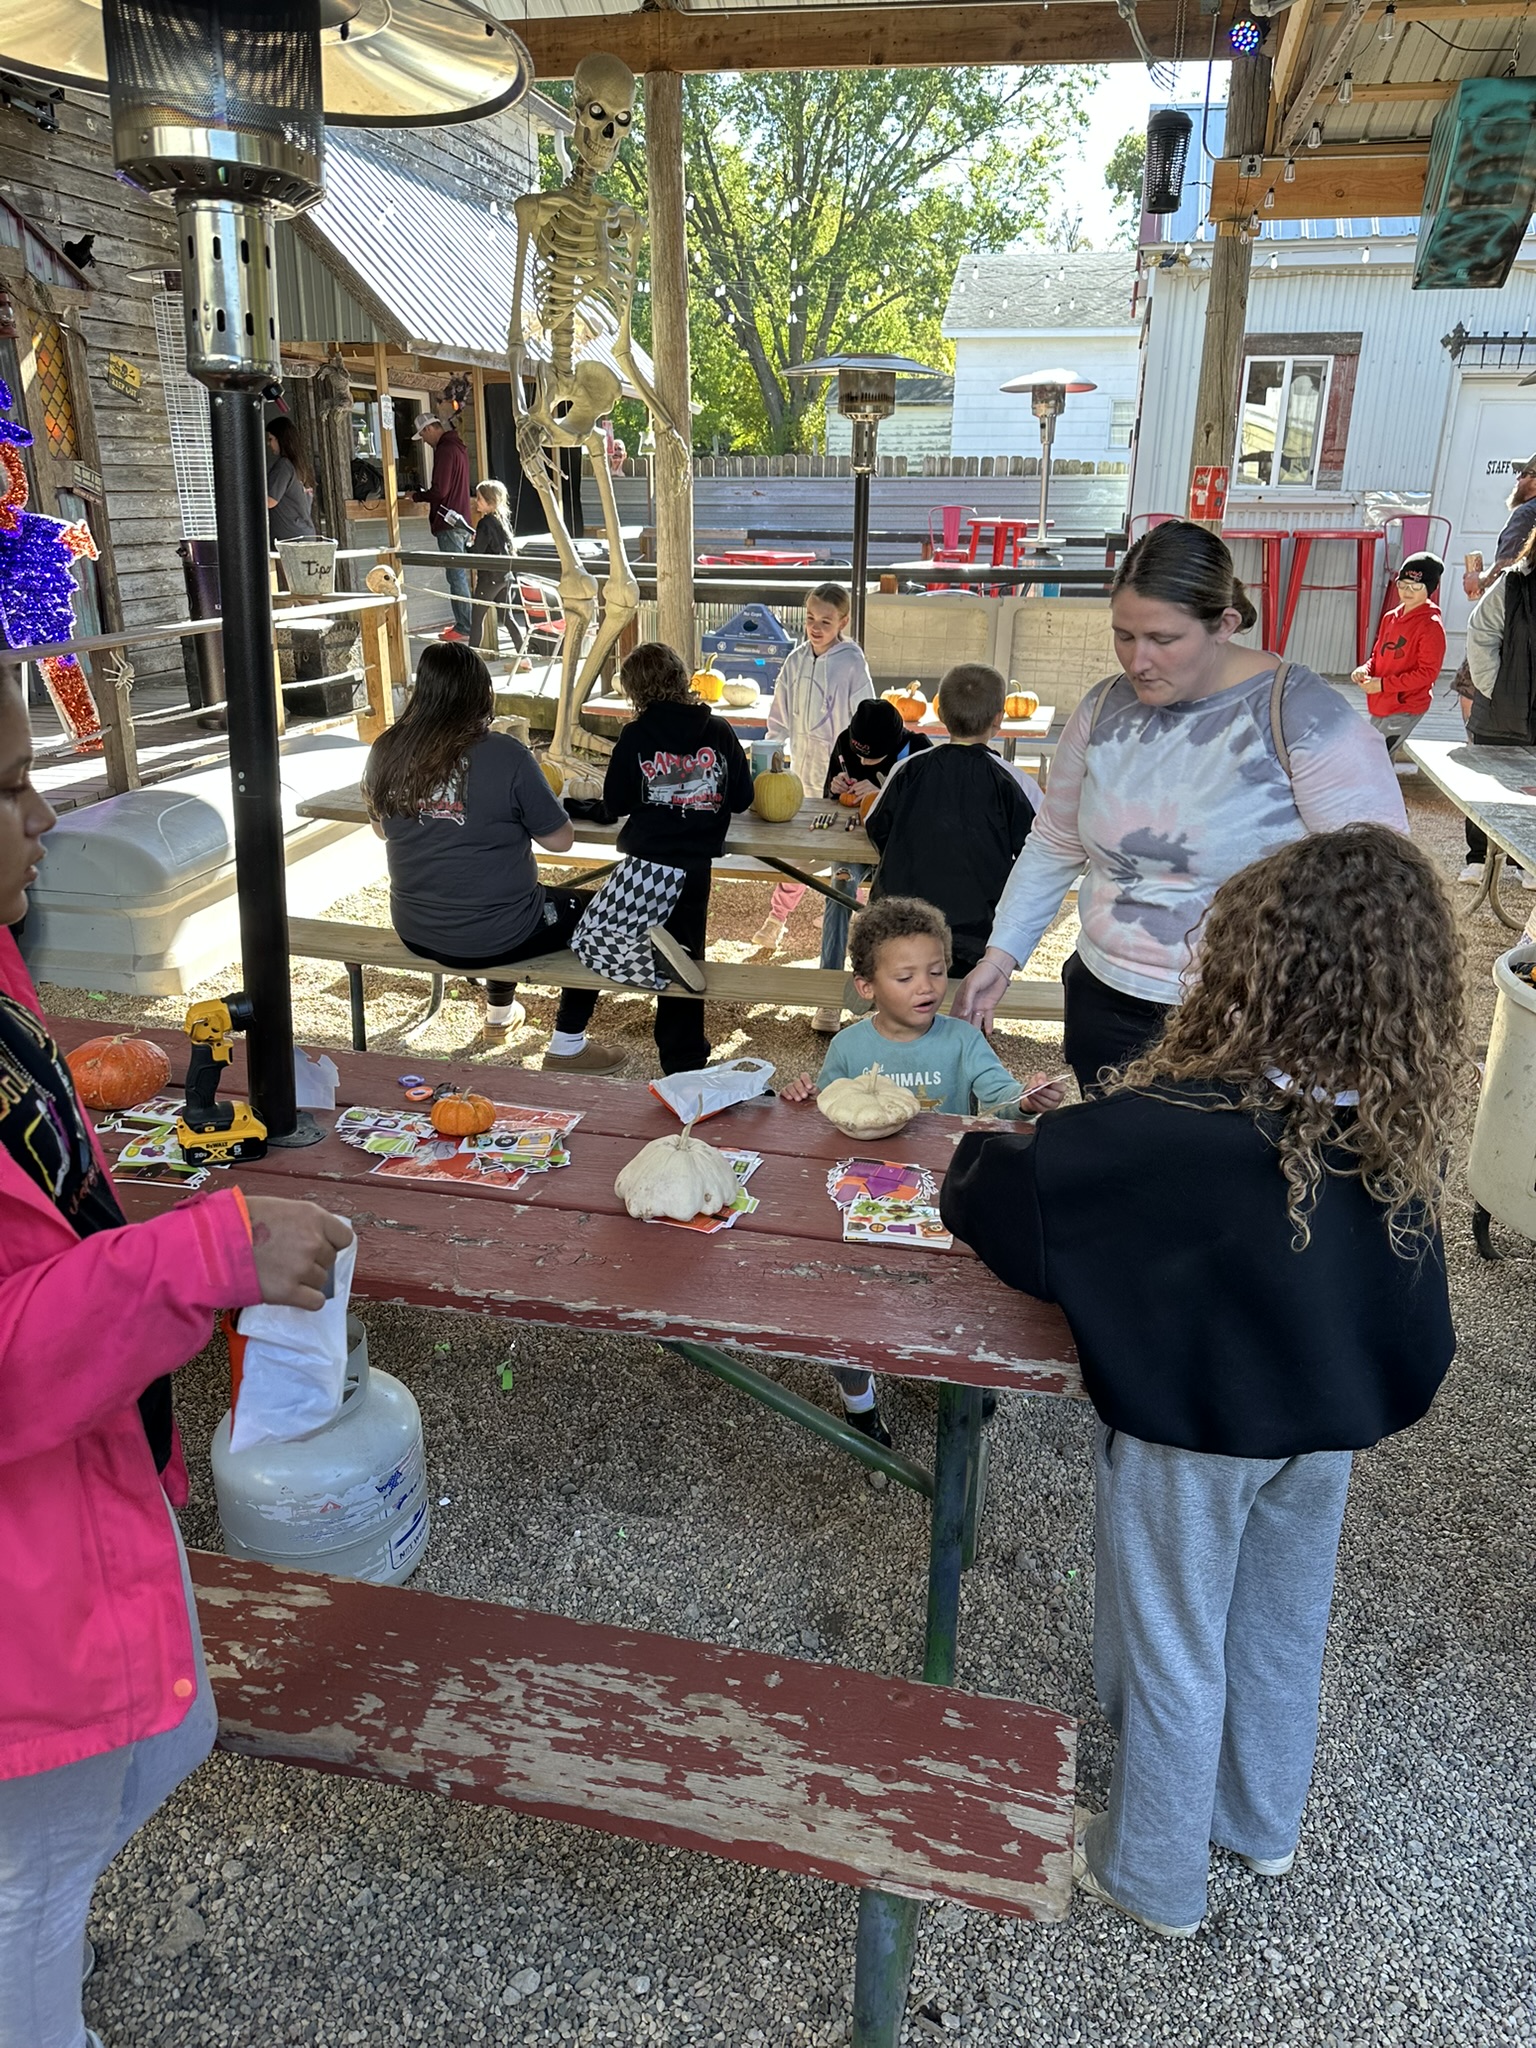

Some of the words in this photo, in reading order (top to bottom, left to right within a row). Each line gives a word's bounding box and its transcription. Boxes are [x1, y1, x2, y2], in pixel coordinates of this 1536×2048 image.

[1486, 460, 1512, 475] STAFF
[301, 560, 332, 580] Tips
[640, 747, 717, 782] BANGO
[877, 1070, 942, 1088] IMALS
[206, 1148, 231, 1161] XR
[233, 1144, 242, 1153] 5
